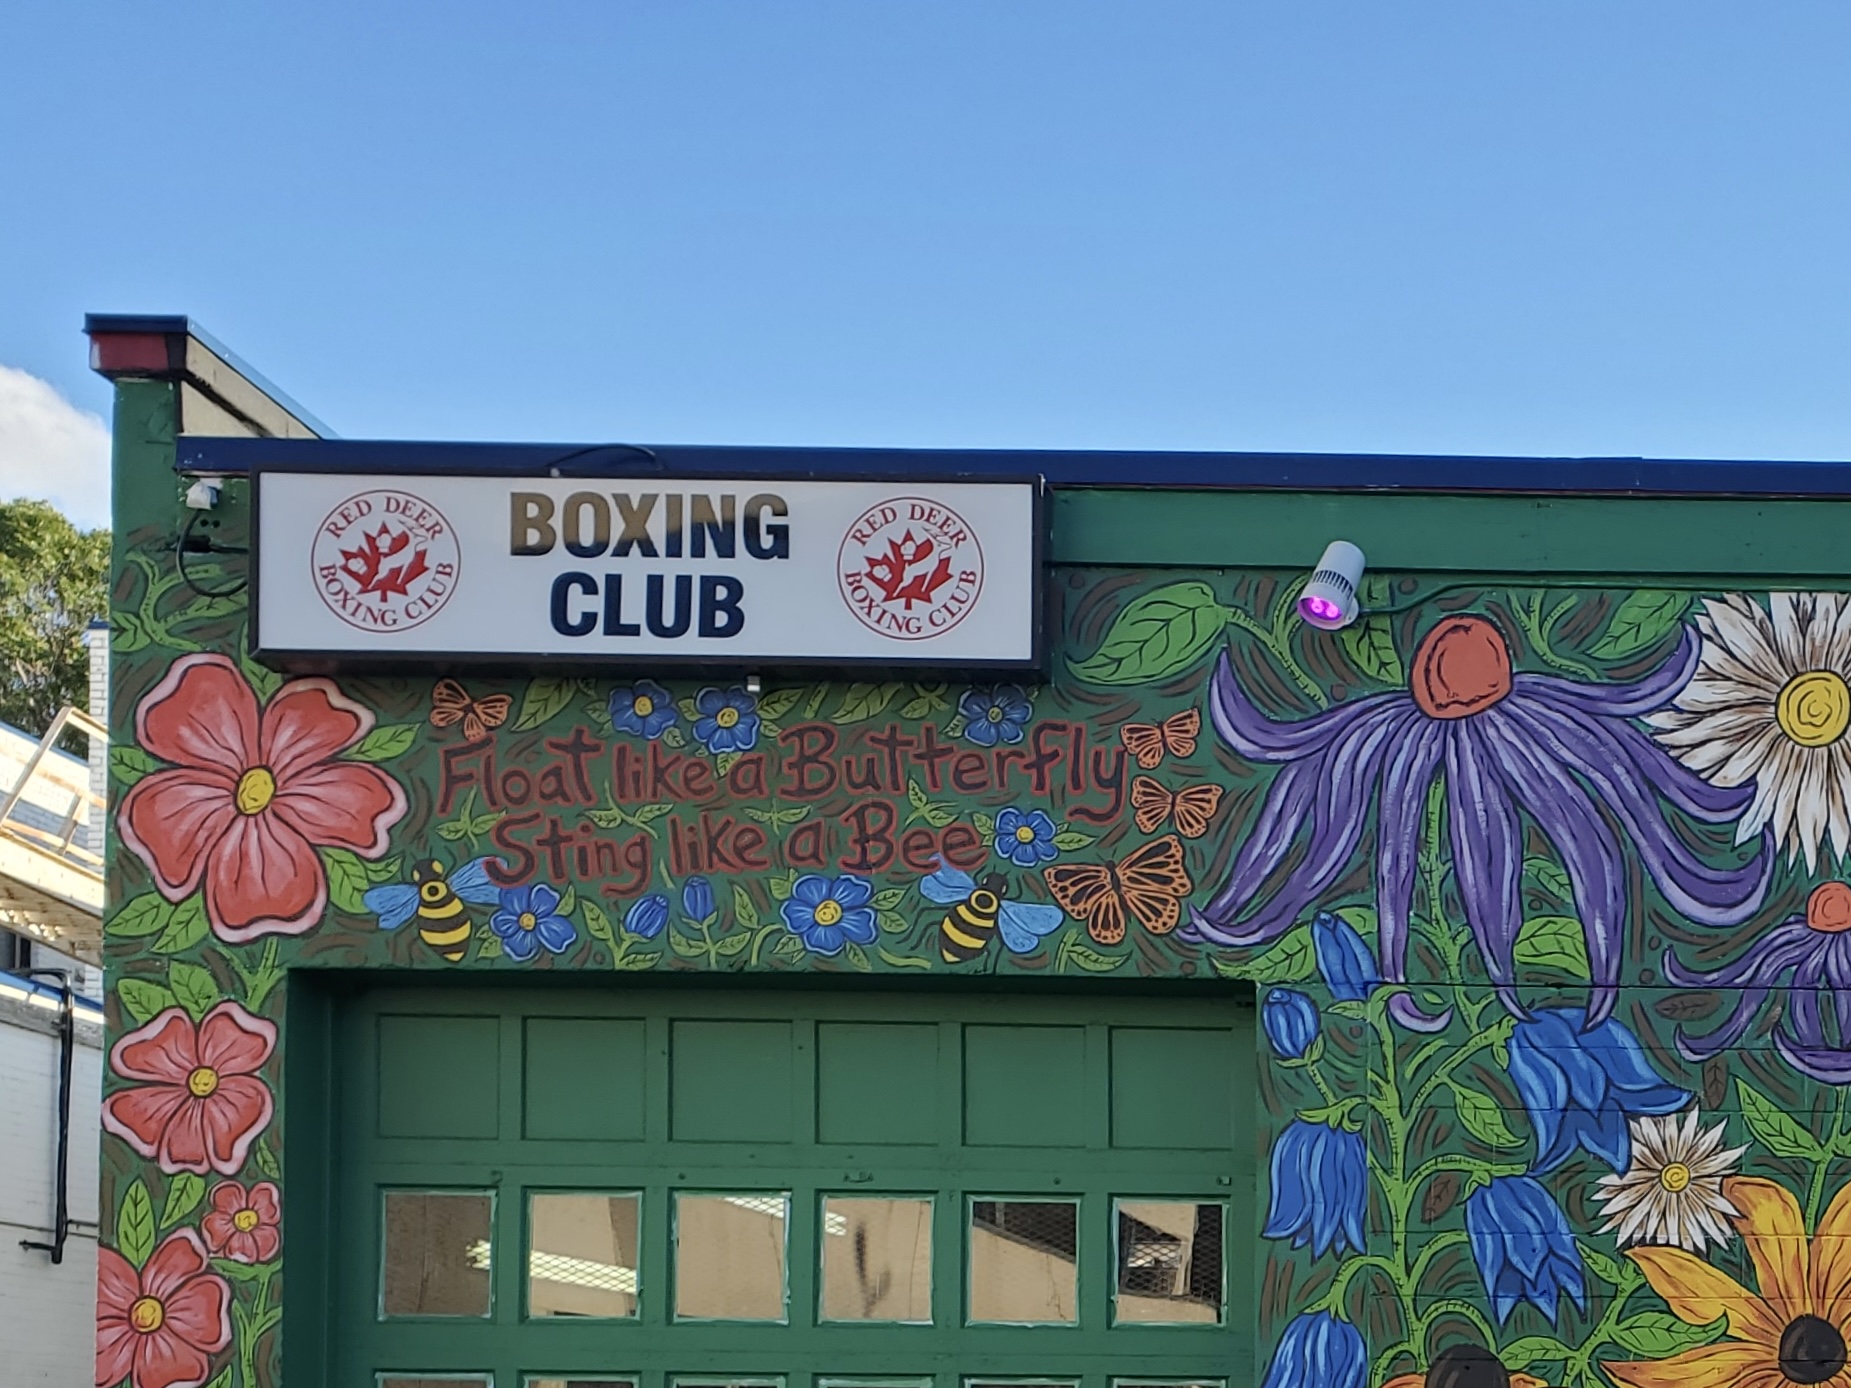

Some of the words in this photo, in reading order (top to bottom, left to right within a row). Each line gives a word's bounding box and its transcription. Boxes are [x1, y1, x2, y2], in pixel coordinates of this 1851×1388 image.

[325, 499, 372, 539] RED
[384, 496, 443, 541] DEER
[510, 491, 790, 560] BOXING
[852, 506, 898, 547] RED
[908, 503, 967, 549] DEER
[319, 563, 398, 627] BOXING
[404, 562, 454, 619] CLUB
[550, 571, 745, 638] CLUB
[845, 570, 923, 634] BOXING
[928, 570, 977, 627] CLUB
[436, 725, 605, 817] Float
[613, 740, 717, 801] like
[727, 752, 768, 799] a
[778, 719, 1129, 826] Butterfly
[483, 810, 650, 898] Sting
[668, 809, 773, 876] like
[786, 817, 827, 868] a
[839, 799, 990, 876] Bee
